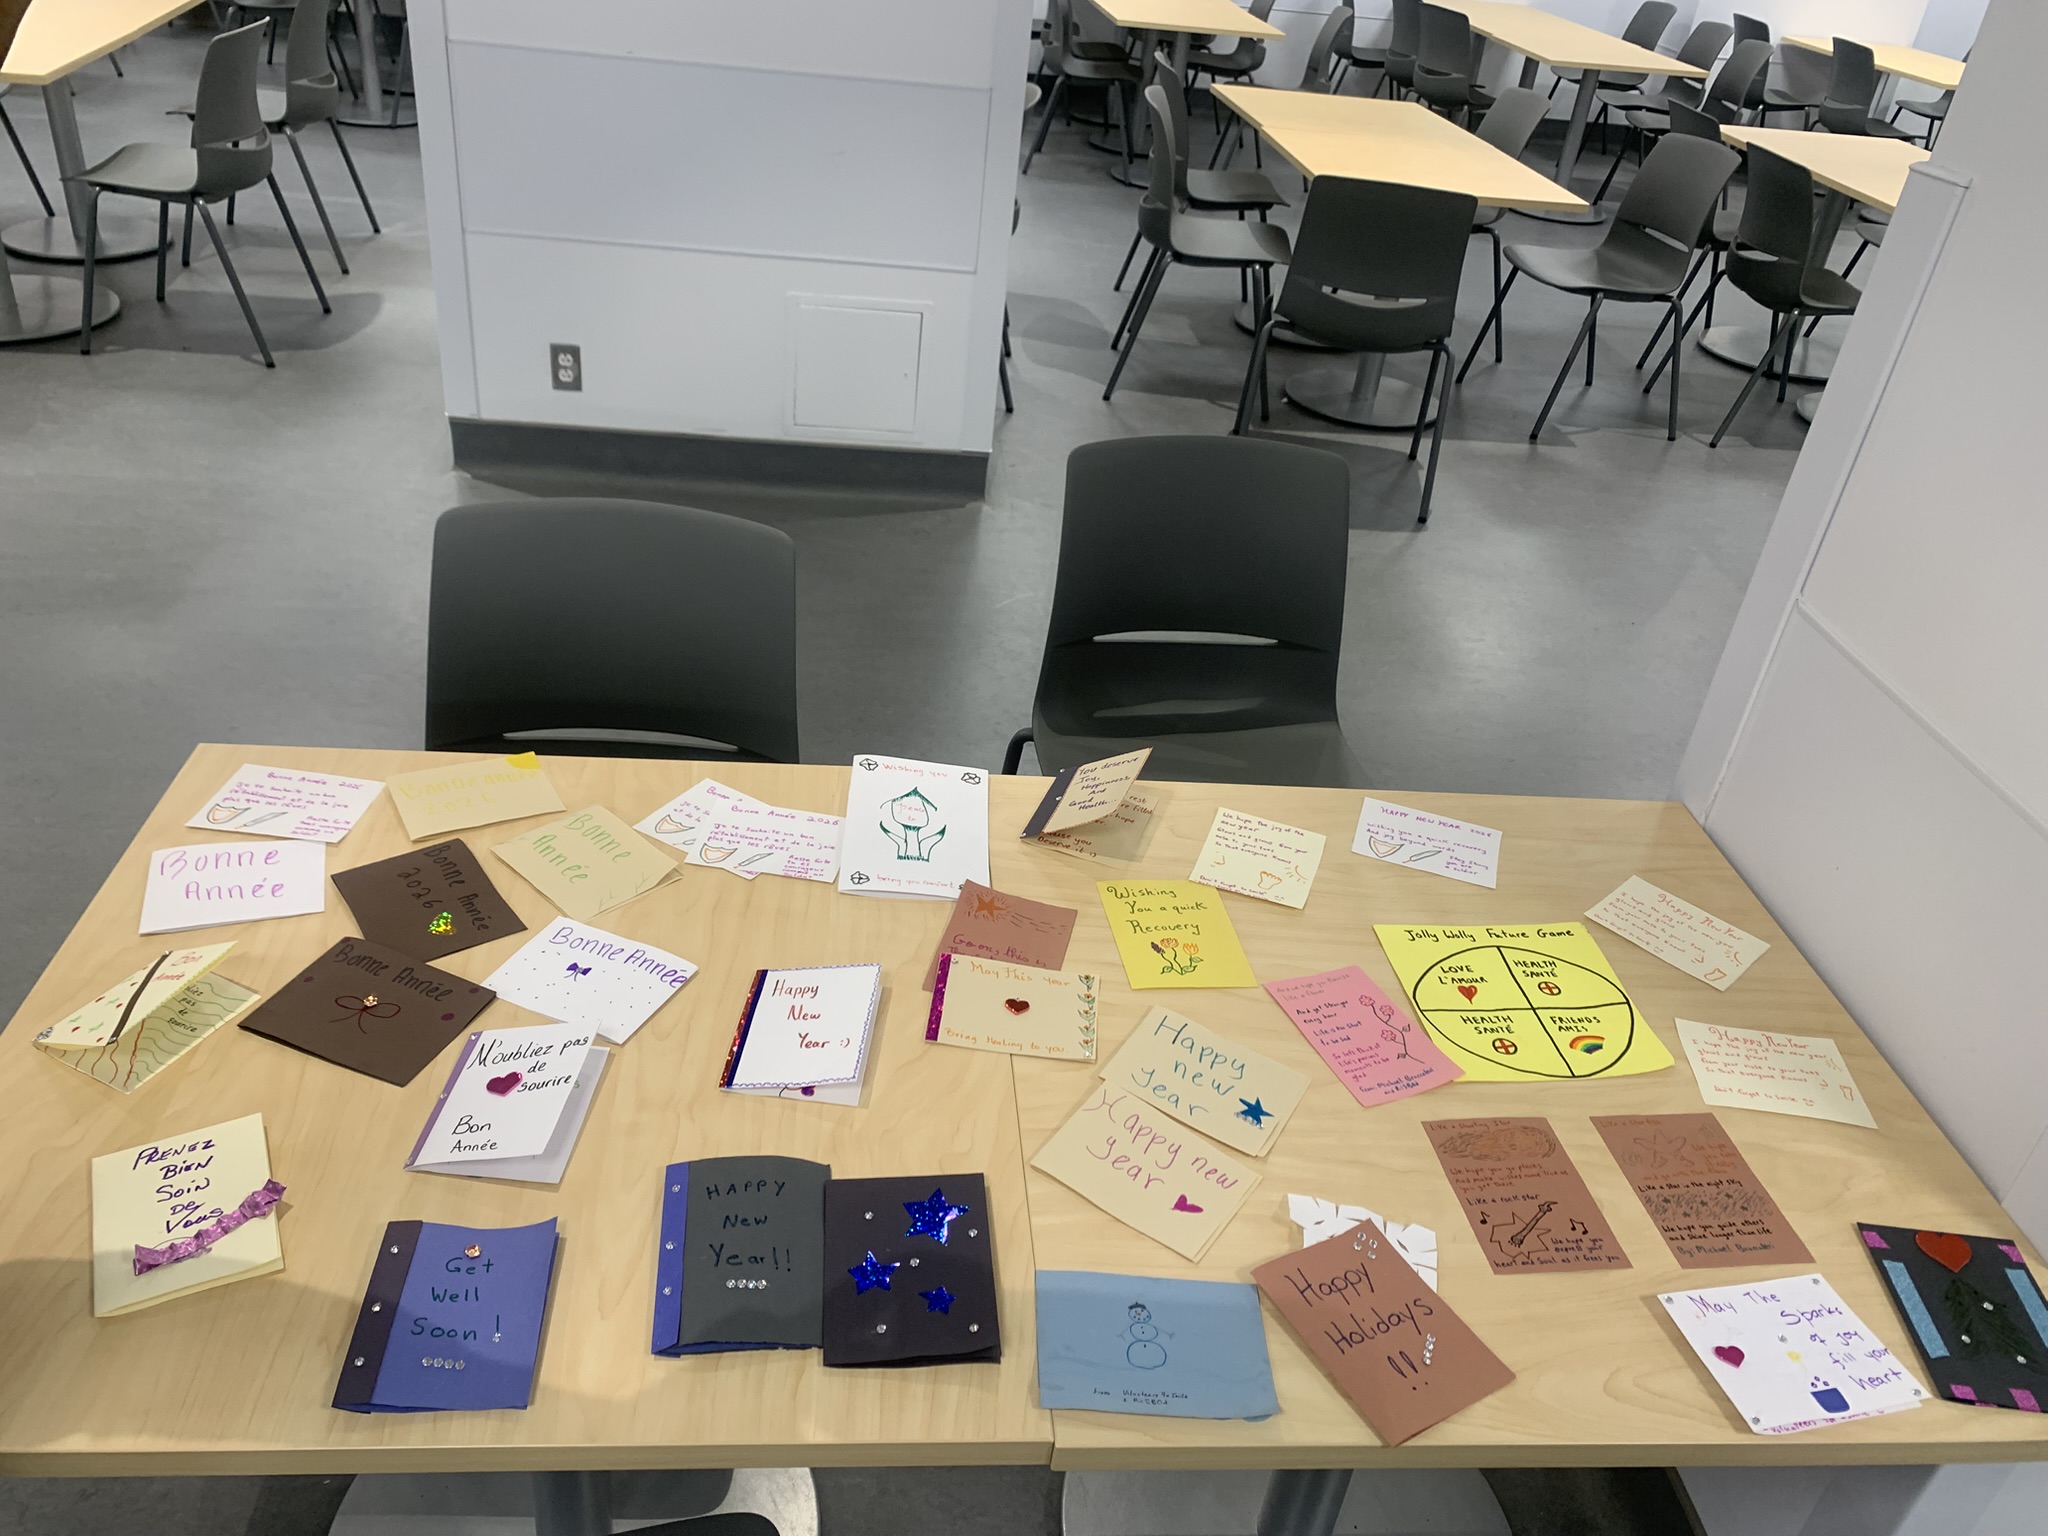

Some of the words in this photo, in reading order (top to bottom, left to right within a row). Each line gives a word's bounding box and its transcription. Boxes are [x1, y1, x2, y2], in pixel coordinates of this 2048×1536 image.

[1078, 766, 1097, 776] You
[1100, 757, 1140, 769] deserve
[1068, 796, 1094, 807] Good
[731, 804, 760, 815] Bonne
[767, 810, 797, 820] Année
[806, 815, 840, 826] 2026
[1416, 816, 1436, 825] NEW
[568, 813, 632, 863] Bonne
[159, 847, 282, 880] Bonne
[531, 833, 589, 884] Année
[184, 877, 285, 902] Année
[396, 866, 443, 910] 2026
[424, 844, 465, 888] Bonne
[457, 892, 490, 932] Année
[1106, 885, 1178, 900] Wishing
[1125, 900, 1153, 914] You
[1172, 901, 1208, 915] quick
[1125, 919, 1201, 936] Recovery
[1404, 929, 1440, 942] Jolly
[1486, 928, 1530, 940] Future
[1536, 928, 1576, 939] Game
[549, 926, 626, 967] Bonne
[624, 948, 689, 989] Année
[1003, 945, 1029, 963] this
[1512, 959, 1558, 969] HEALTH
[332, 943, 391, 977] Bonne
[391, 966, 454, 1003] Année
[969, 960, 999, 979] May
[1440, 965, 1474, 974] LOVE
[1522, 968, 1559, 978] SANTÉ
[771, 979, 819, 999] Happy
[1437, 975, 1488, 985] L'AMOUR
[787, 1004, 822, 1021] New
[1459, 1015, 1514, 1025] HEALTH
[1549, 1015, 1601, 1025] FRIENDS
[943, 1026, 978, 1045] Bring
[986, 1035, 1023, 1051] Healing
[1030, 1041, 1040, 1051] to
[1475, 1024, 1516, 1034] SANTÉ
[1557, 1025, 1589, 1033] AMIS
[1708, 1026, 1763, 1048] Happy
[1761, 1032, 1787, 1048] New
[559, 1035, 590, 1056] pas
[798, 1032, 831, 1049] Year
[1154, 1014, 1246, 1080] Happy
[527, 1060, 547, 1074] de
[517, 1074, 572, 1093] sourire
[1174, 1060, 1235, 1096] new
[451, 1114, 491, 1136] Bon
[449, 1138, 499, 1154] Année
[1081, 1088, 1182, 1170] Happy
[1191, 1156, 1239, 1190] new
[132, 1138, 217, 1171] PRENEZ
[1085, 1135, 1166, 1190] year
[705, 1179, 786, 1201] HAPPY
[722, 1214, 768, 1231] New
[445, 1257, 495, 1275] Get
[708, 1242, 792, 1273] Year!!
[430, 1286, 480, 1304] Well
[1283, 1262, 1376, 1309] Happy
[1686, 1293, 1739, 1319] May
[1742, 1289, 1782, 1305] The
[1779, 1303, 1845, 1328] Sparks
[409, 1316, 478, 1342] Soon
[1323, 1297, 1434, 1356] Holidays
[1808, 1333, 1827, 1346] of
[1829, 1352, 1858, 1370] fill
[1863, 1347, 1890, 1364] your
[1847, 1367, 1903, 1391] heart
